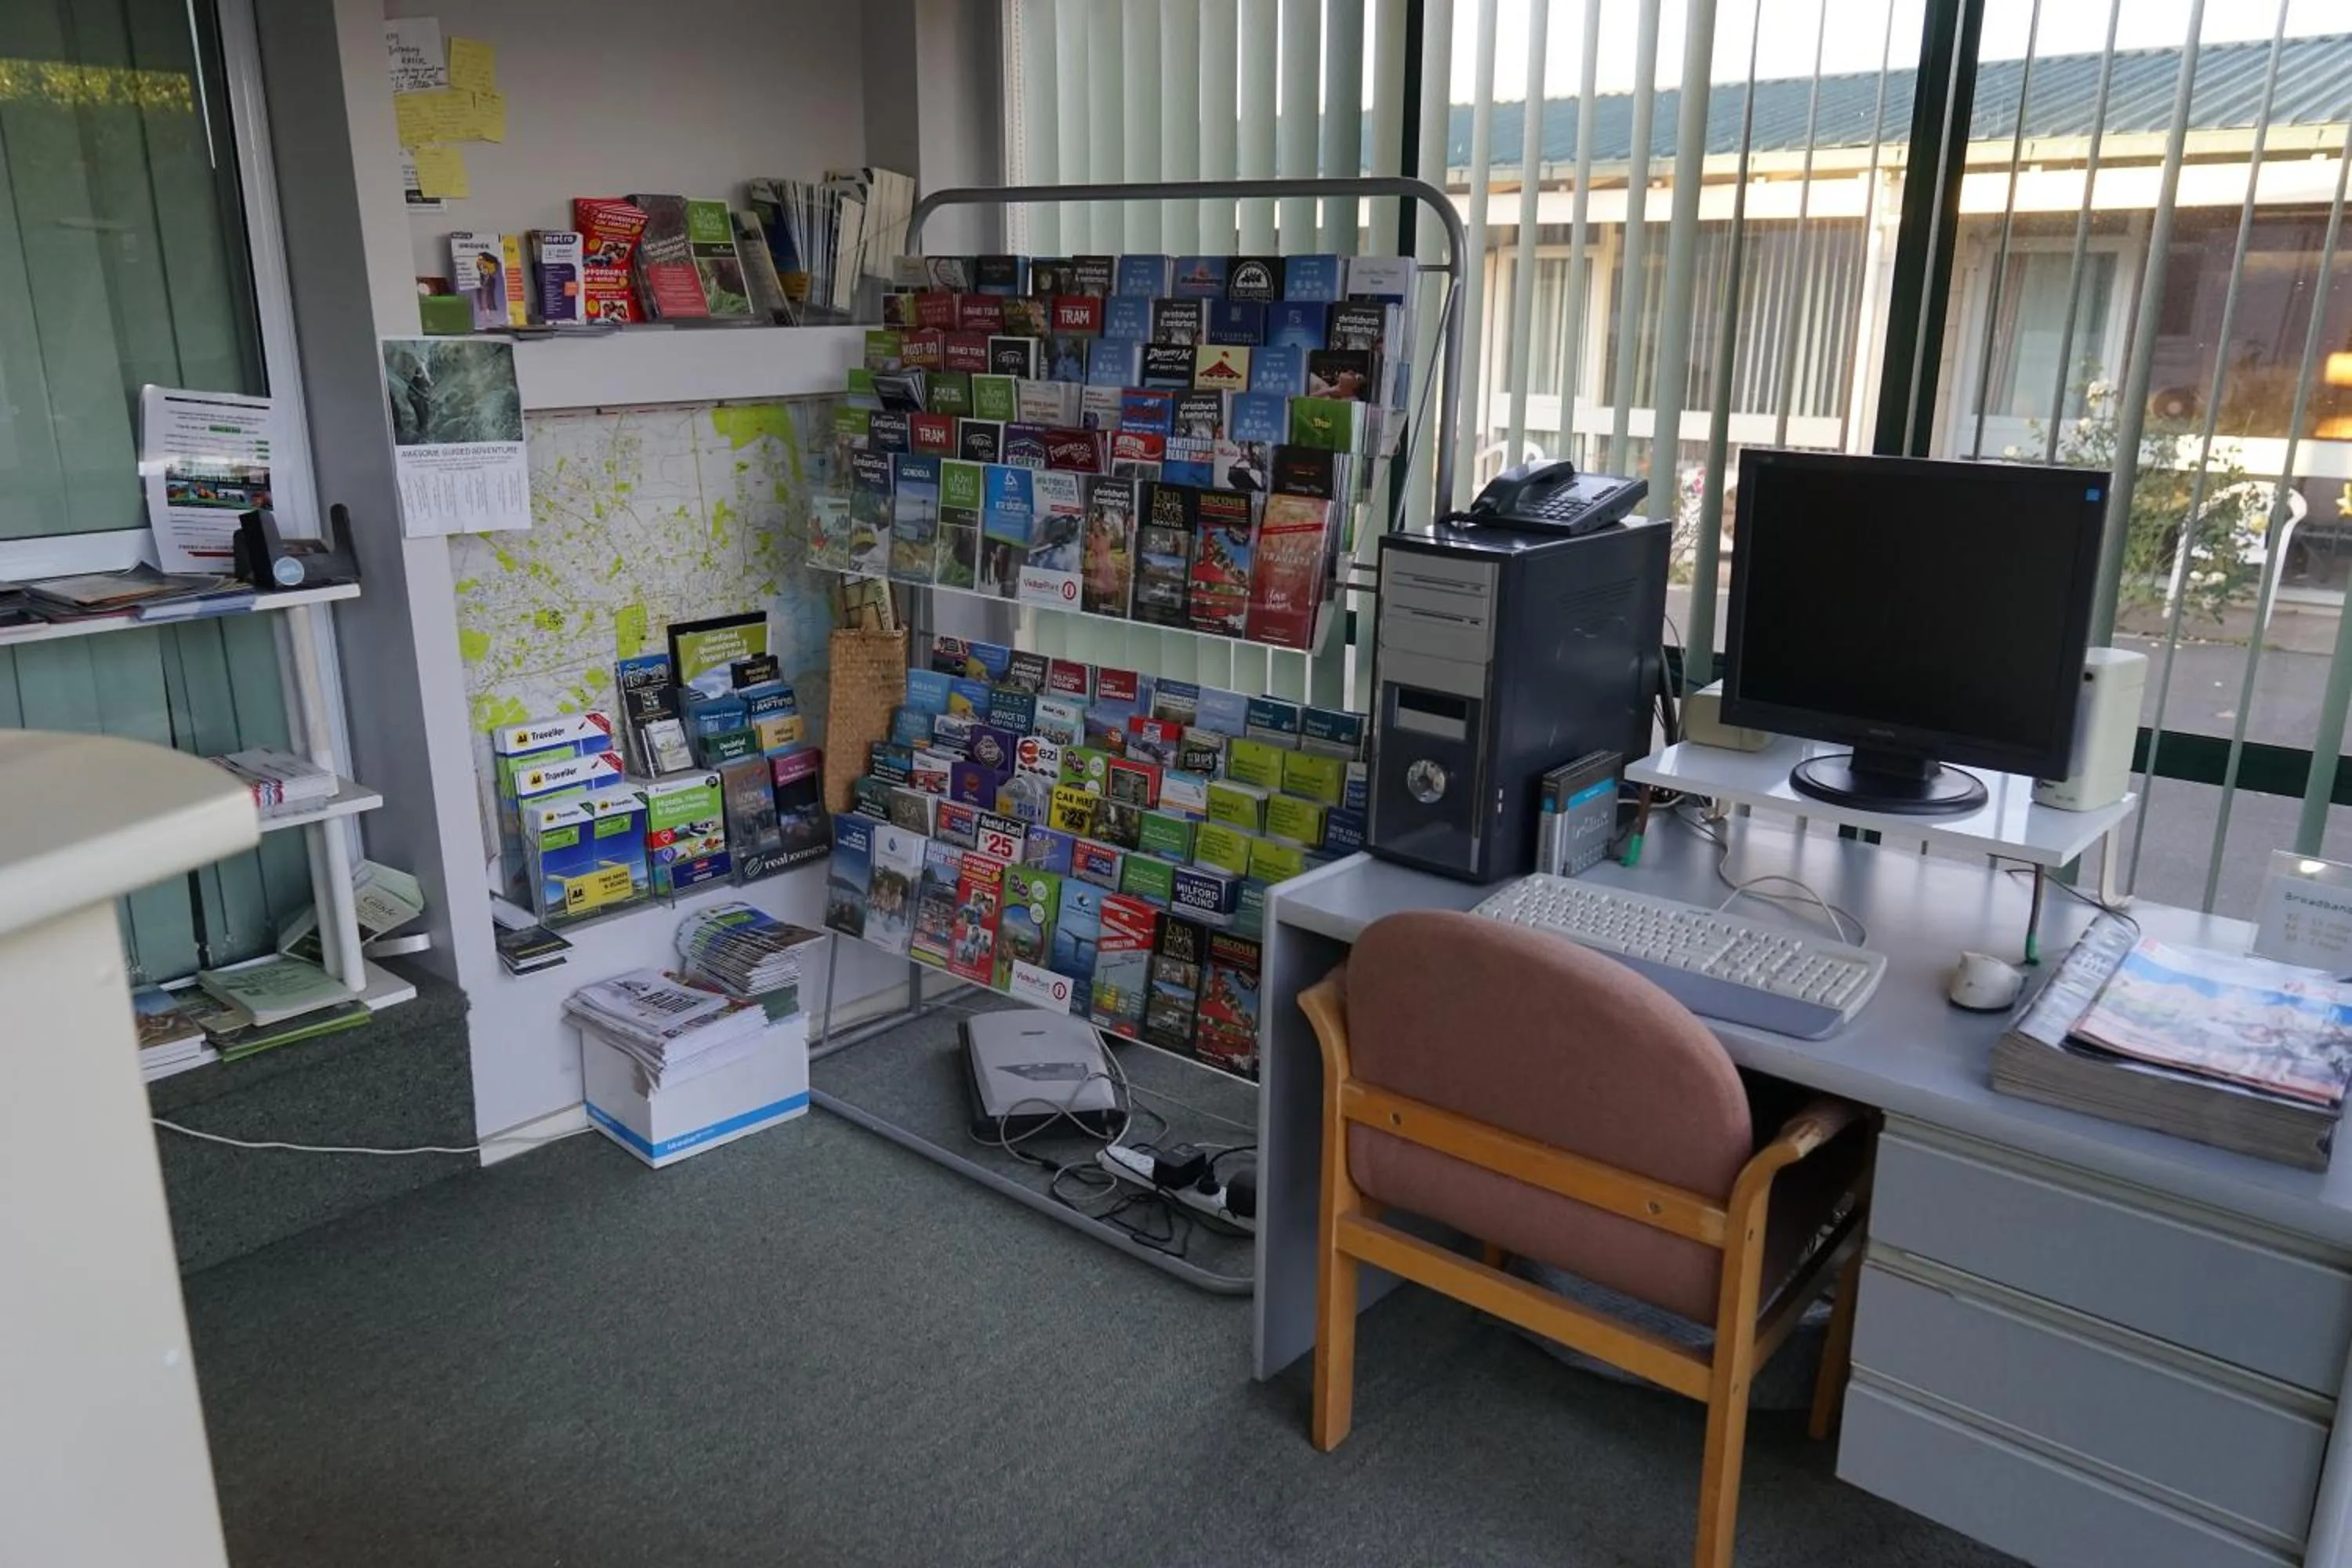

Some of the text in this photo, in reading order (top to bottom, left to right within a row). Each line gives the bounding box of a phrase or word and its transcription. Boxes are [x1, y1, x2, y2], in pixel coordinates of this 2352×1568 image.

[545, 235, 575, 244] metro
[1060, 309, 1090, 325] TRAM
[969, 347, 985, 357] TOUR
[918, 427, 946, 444] TRAM
[902, 468, 931, 478] GONDOLA
[991, 709, 1026, 724] ADVICE TO
[1039, 747, 1058, 761] ezi
[1055, 790, 1074, 804] CAR
[1176, 882, 1219, 902] MILFORD
[1180, 893, 1214, 909] SOUND
